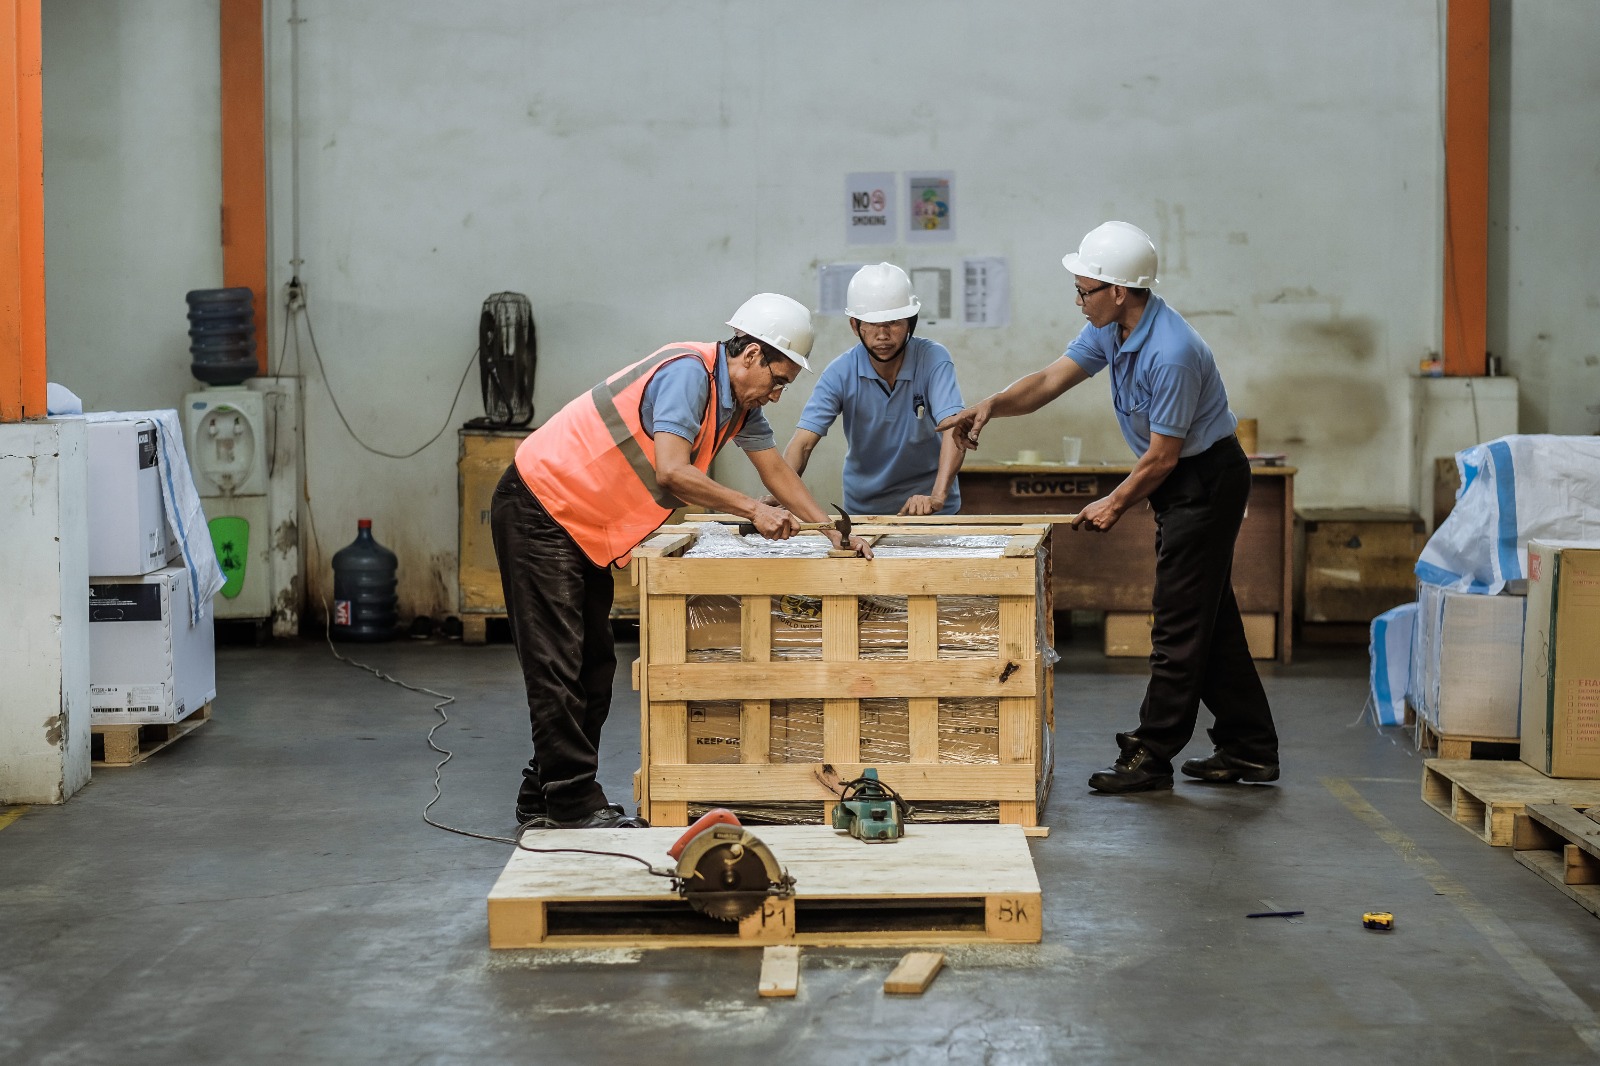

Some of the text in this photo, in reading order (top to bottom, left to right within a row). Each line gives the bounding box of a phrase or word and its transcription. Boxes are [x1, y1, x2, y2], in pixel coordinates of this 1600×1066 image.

[852, 191, 870, 210] NO
[852, 215, 886, 226] SMOKING
[1015, 480, 1092, 495] ROYCE
[696, 737, 723, 745] KEEP
